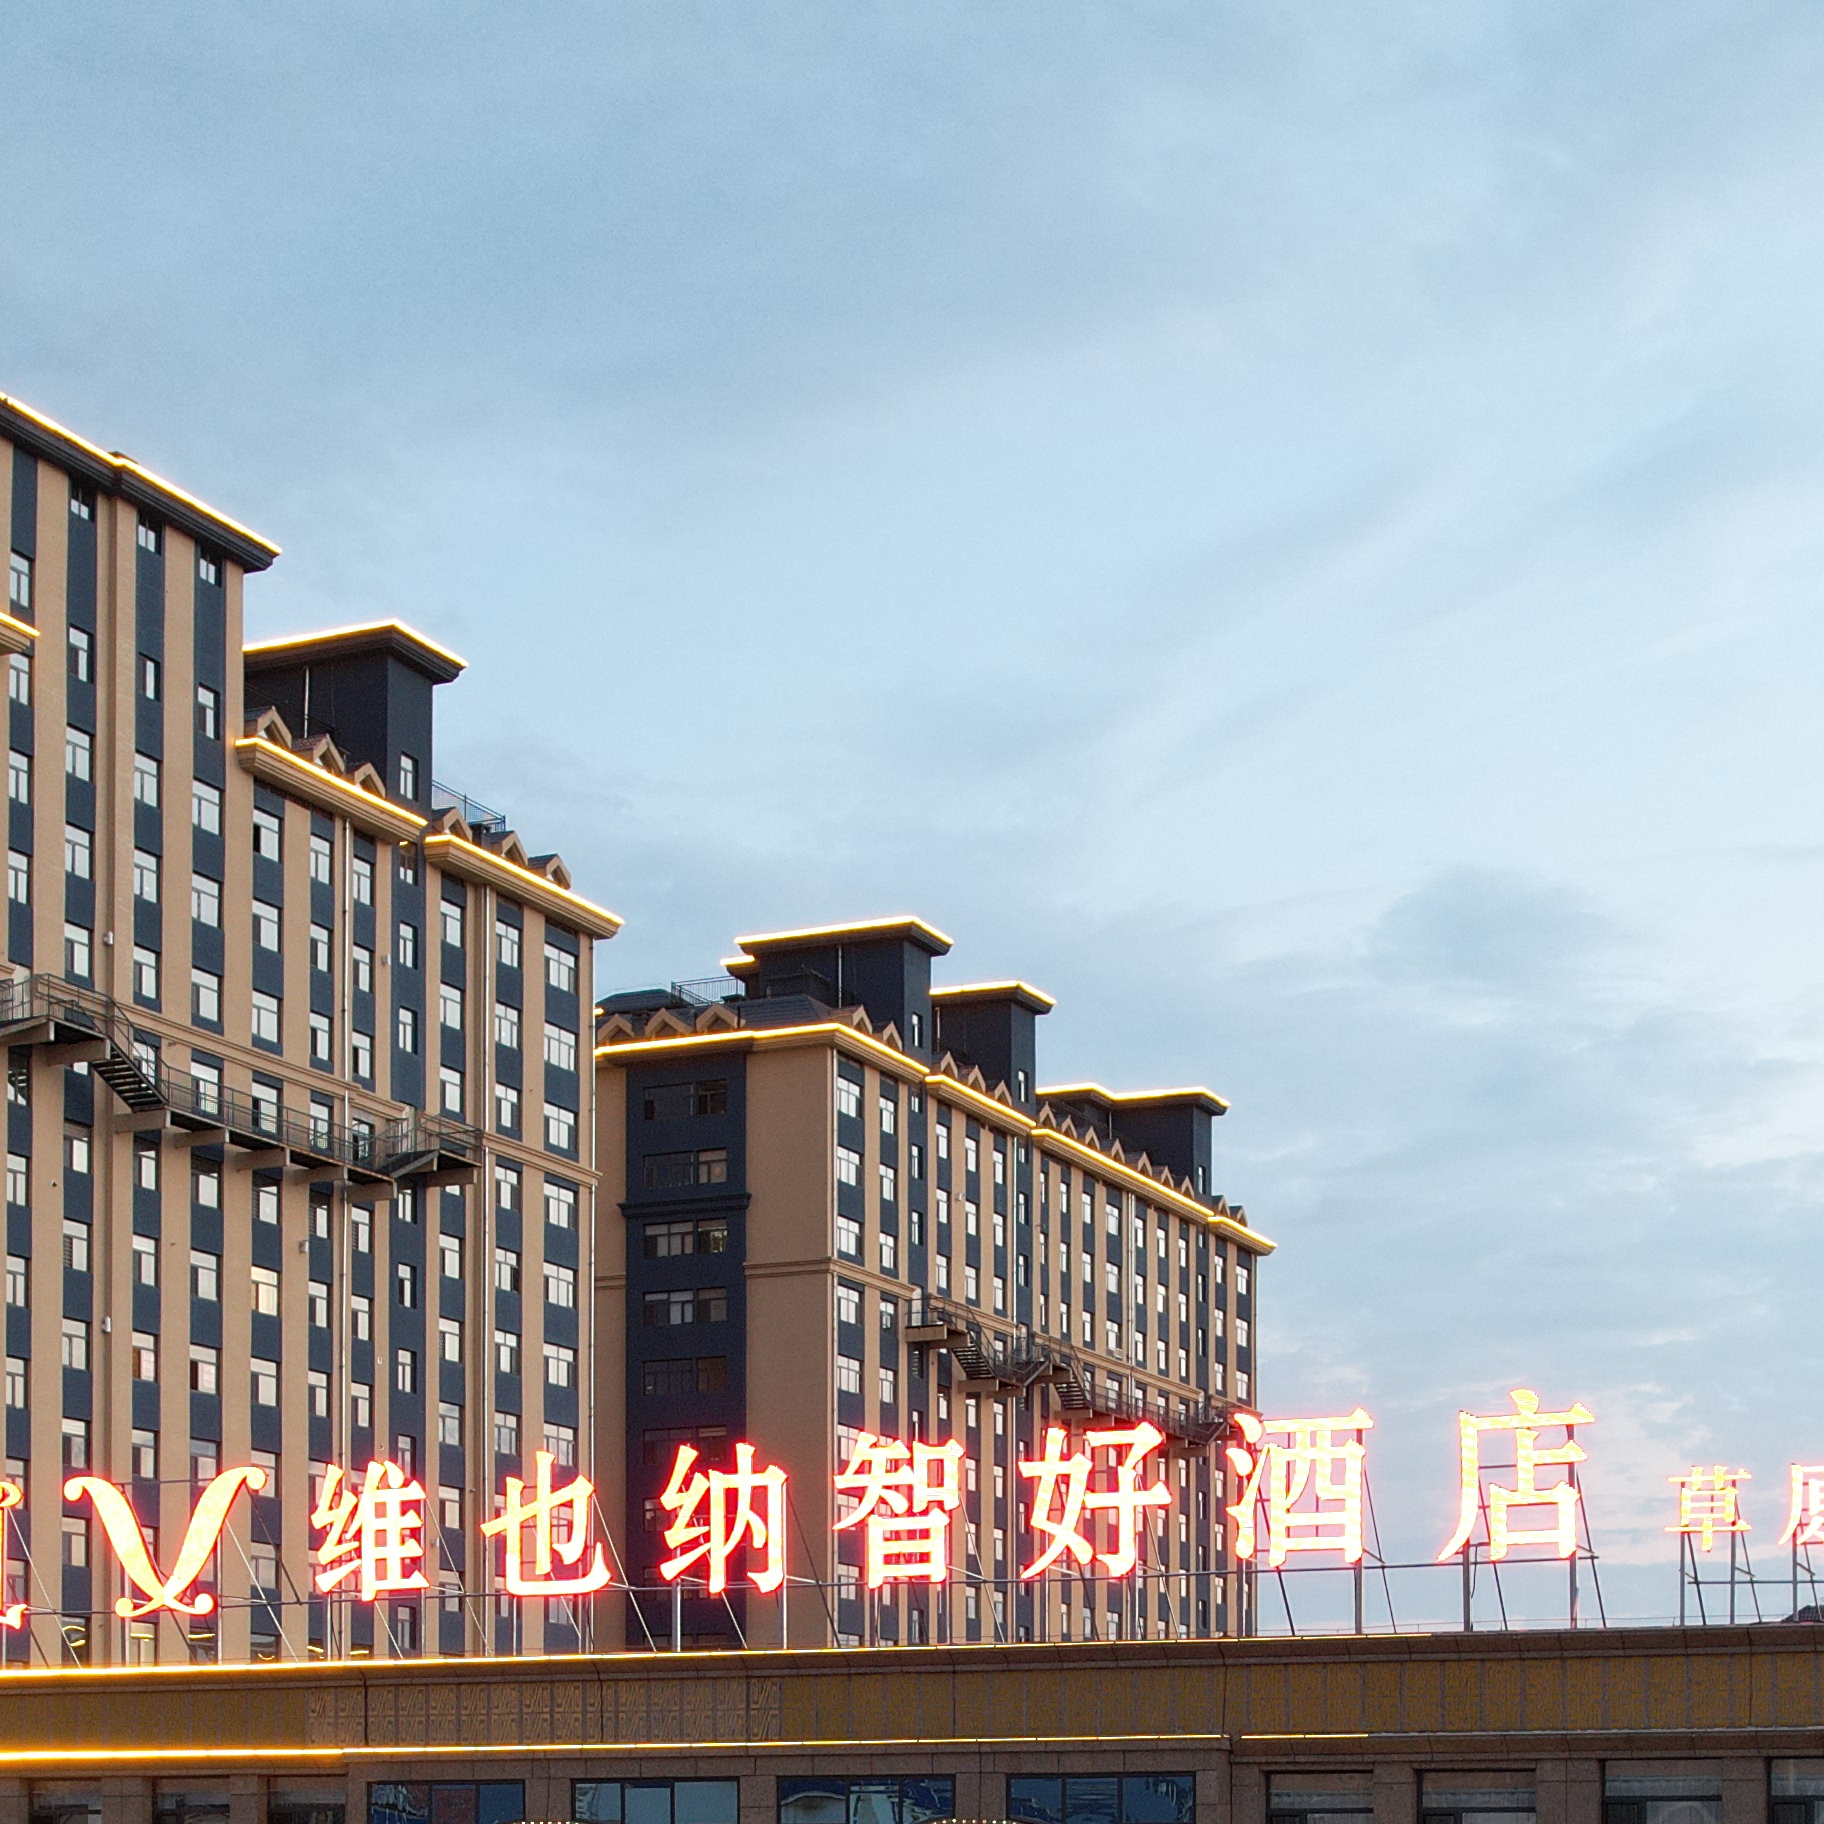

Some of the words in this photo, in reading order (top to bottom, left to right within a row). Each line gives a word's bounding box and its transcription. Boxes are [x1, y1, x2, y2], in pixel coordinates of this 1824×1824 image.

[309, 1388, 1595, 1602] 维也纳智好酒店
